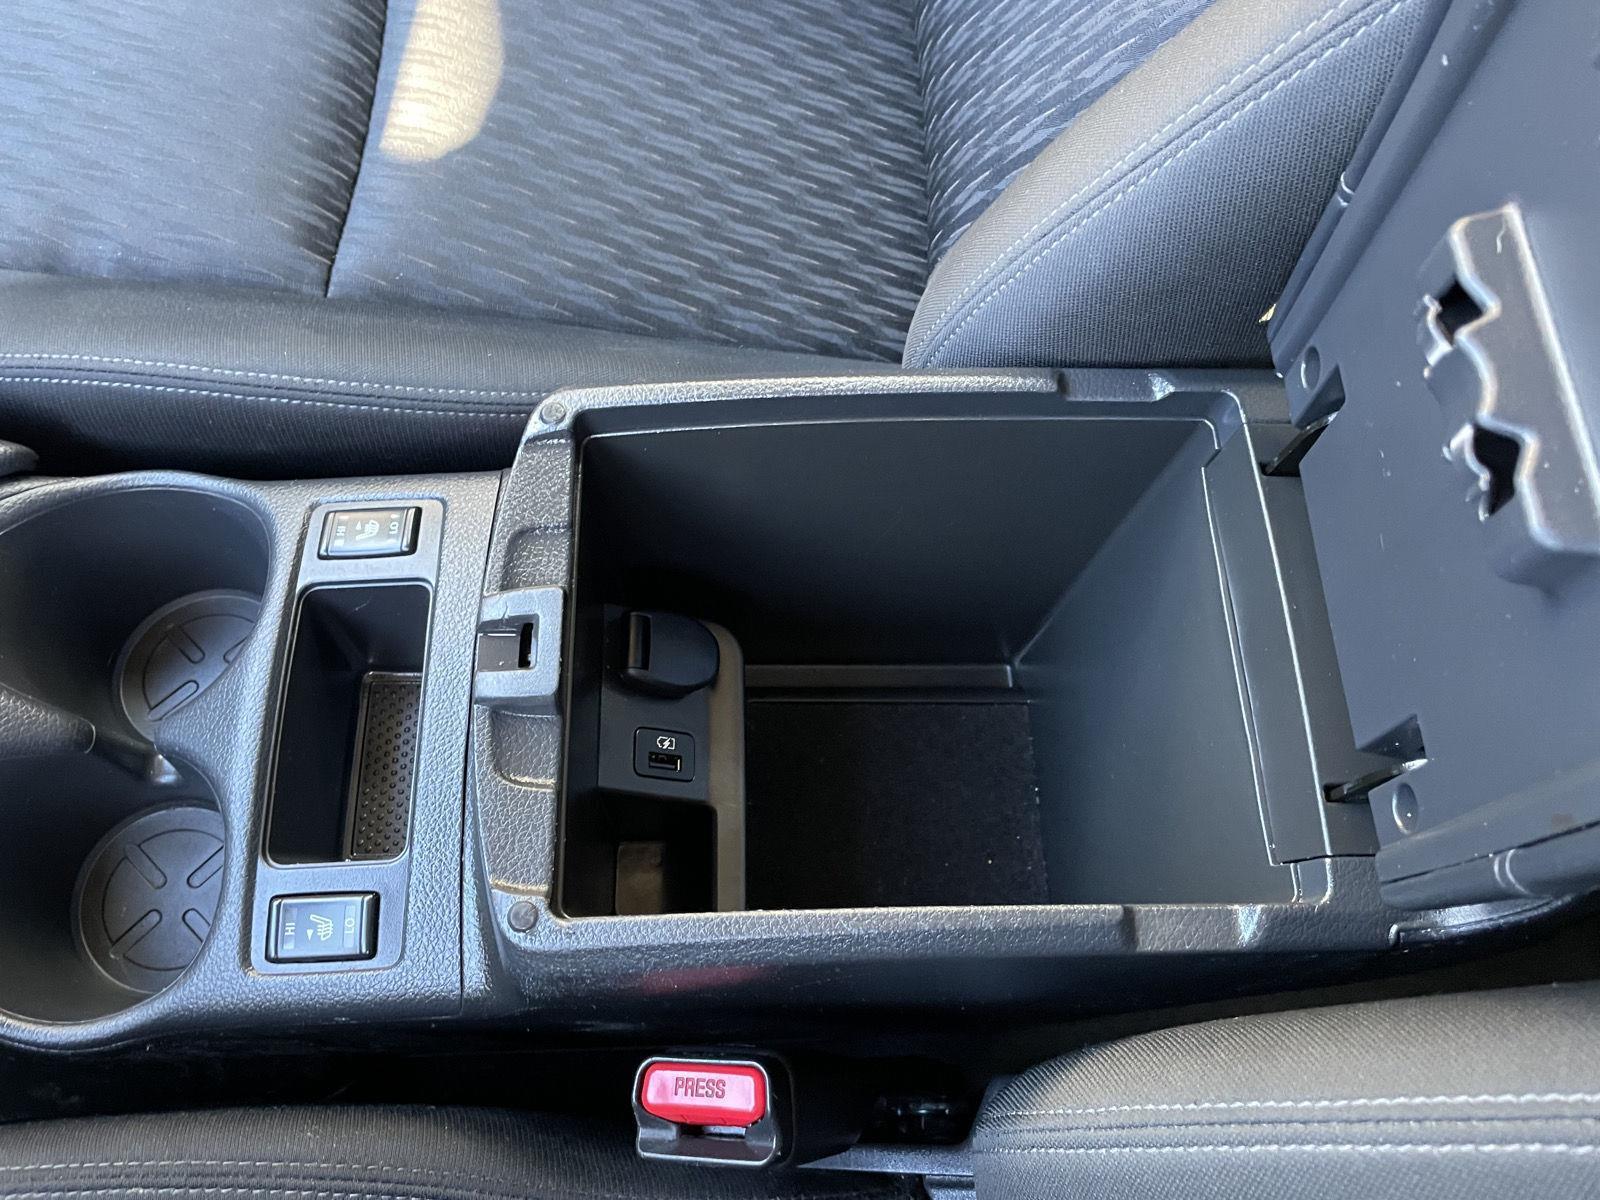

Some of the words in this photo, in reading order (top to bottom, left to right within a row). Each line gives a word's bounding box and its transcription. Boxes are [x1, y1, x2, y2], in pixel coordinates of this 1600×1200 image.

[284, 922, 296, 936] HI
[344, 917, 355, 934] LO
[674, 1076, 727, 1099] PRESS
